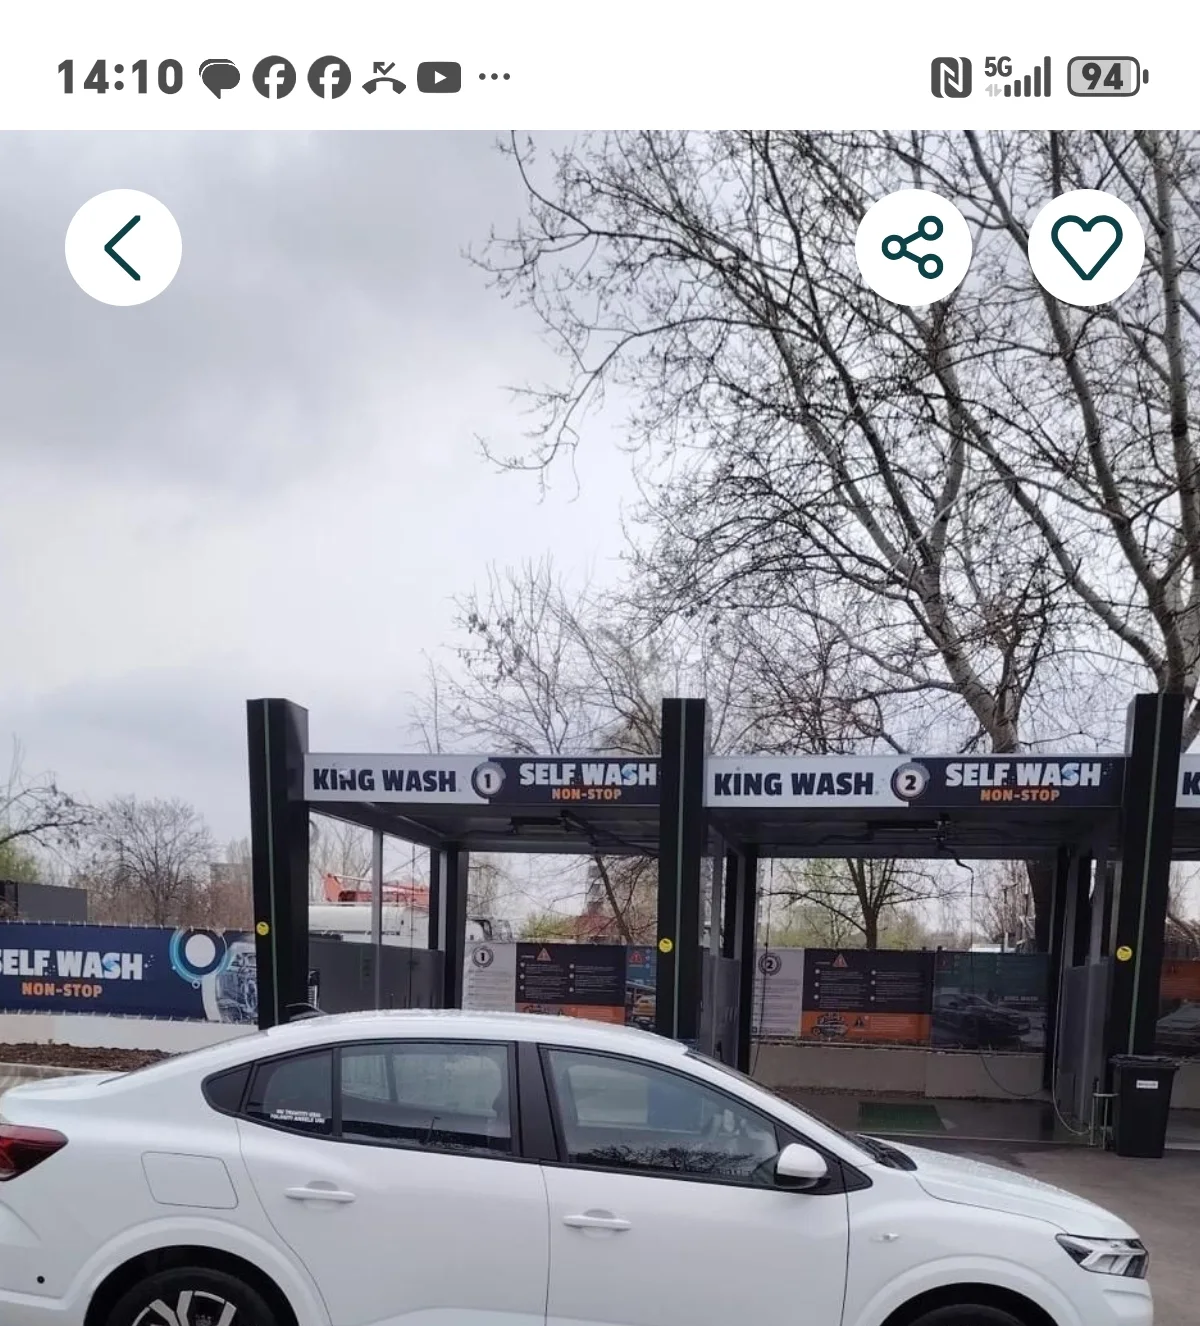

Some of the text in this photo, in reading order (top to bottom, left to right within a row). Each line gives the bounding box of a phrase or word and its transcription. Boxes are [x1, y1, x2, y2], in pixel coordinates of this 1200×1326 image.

[57, 58, 184, 95] 14:10
[984, 56, 1013, 77] 5G
[1081, 62, 1124, 90] 94
[313, 768, 457, 792] KING WASH
[483, 773, 492, 789] 1
[519, 763, 657, 786] SELF WASH
[714, 771, 874, 796] KING WASH
[905, 775, 917, 791] 2
[945, 763, 1101, 787] SELF WASH
[552, 788, 622, 801] NON-STOP
[980, 788, 1060, 802] NON-STOP
[0, 949, 143, 981] ELF WASH
[21, 982, 103, 998] NON-STOP
